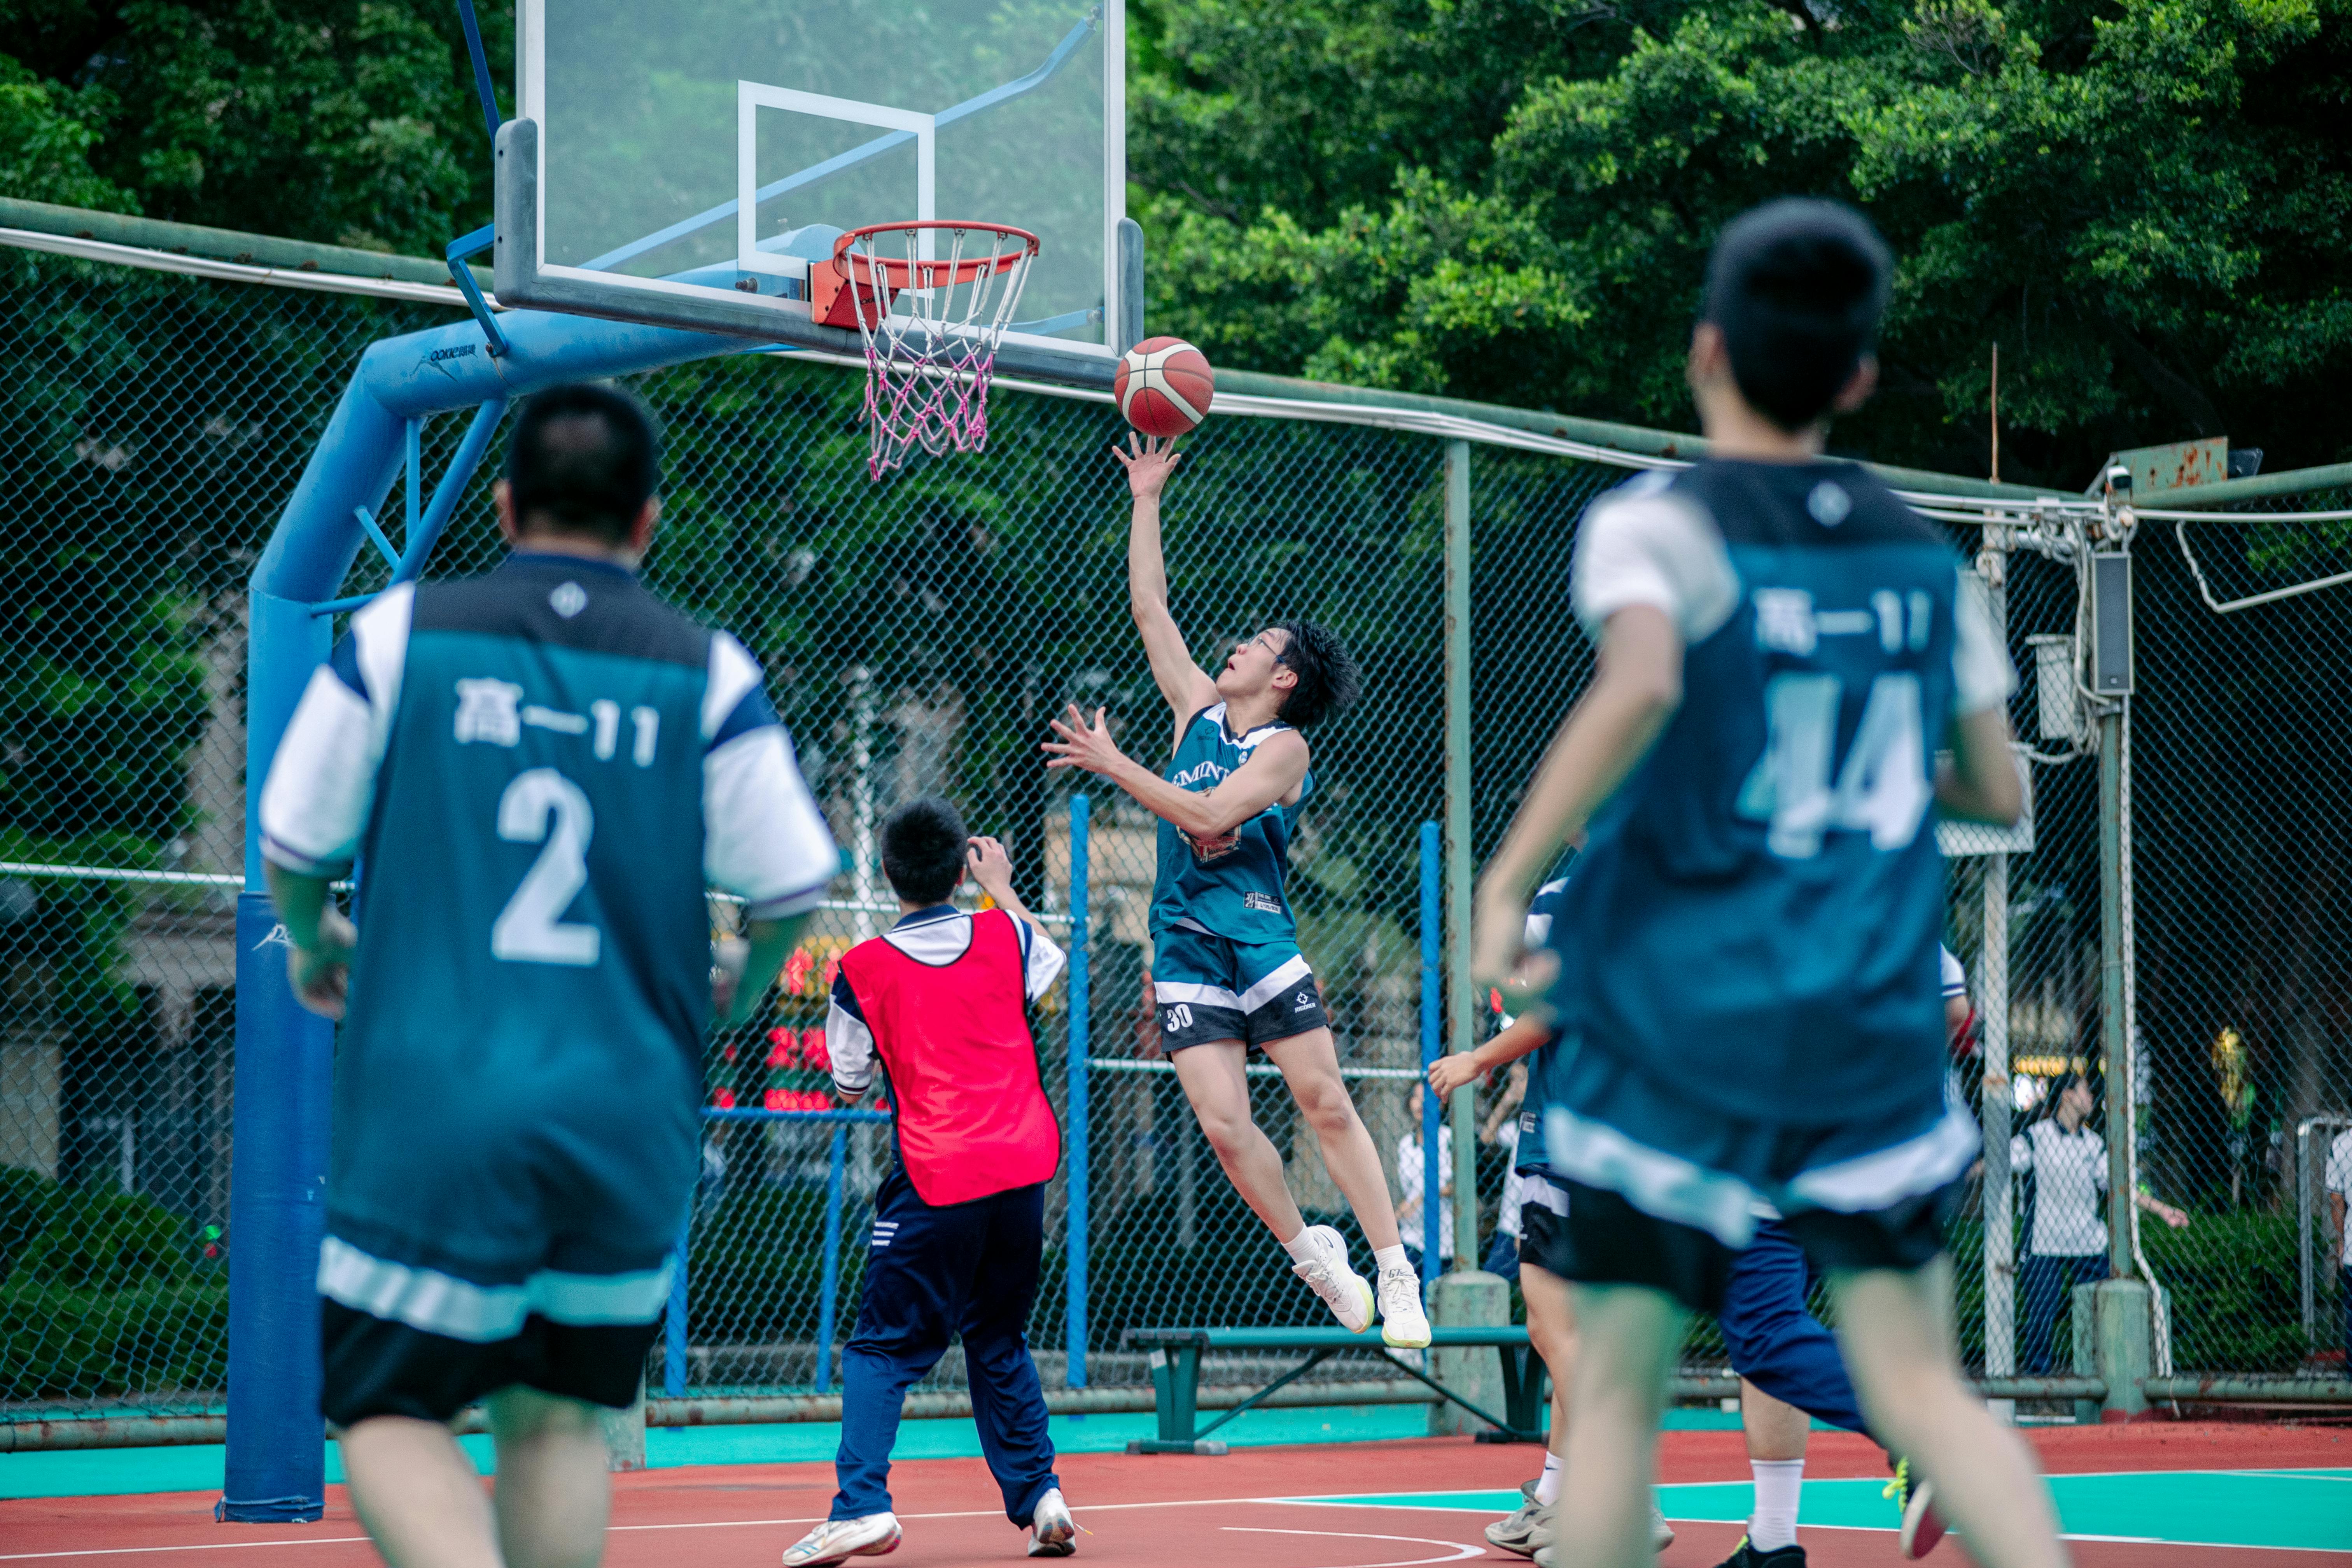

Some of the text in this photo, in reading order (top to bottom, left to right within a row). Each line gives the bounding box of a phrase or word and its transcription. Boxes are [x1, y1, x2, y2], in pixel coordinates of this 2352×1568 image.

[1736, 671, 1934, 859] 44
[492, 768, 600, 966] 2
[1167, 1004, 1193, 1032] 30
